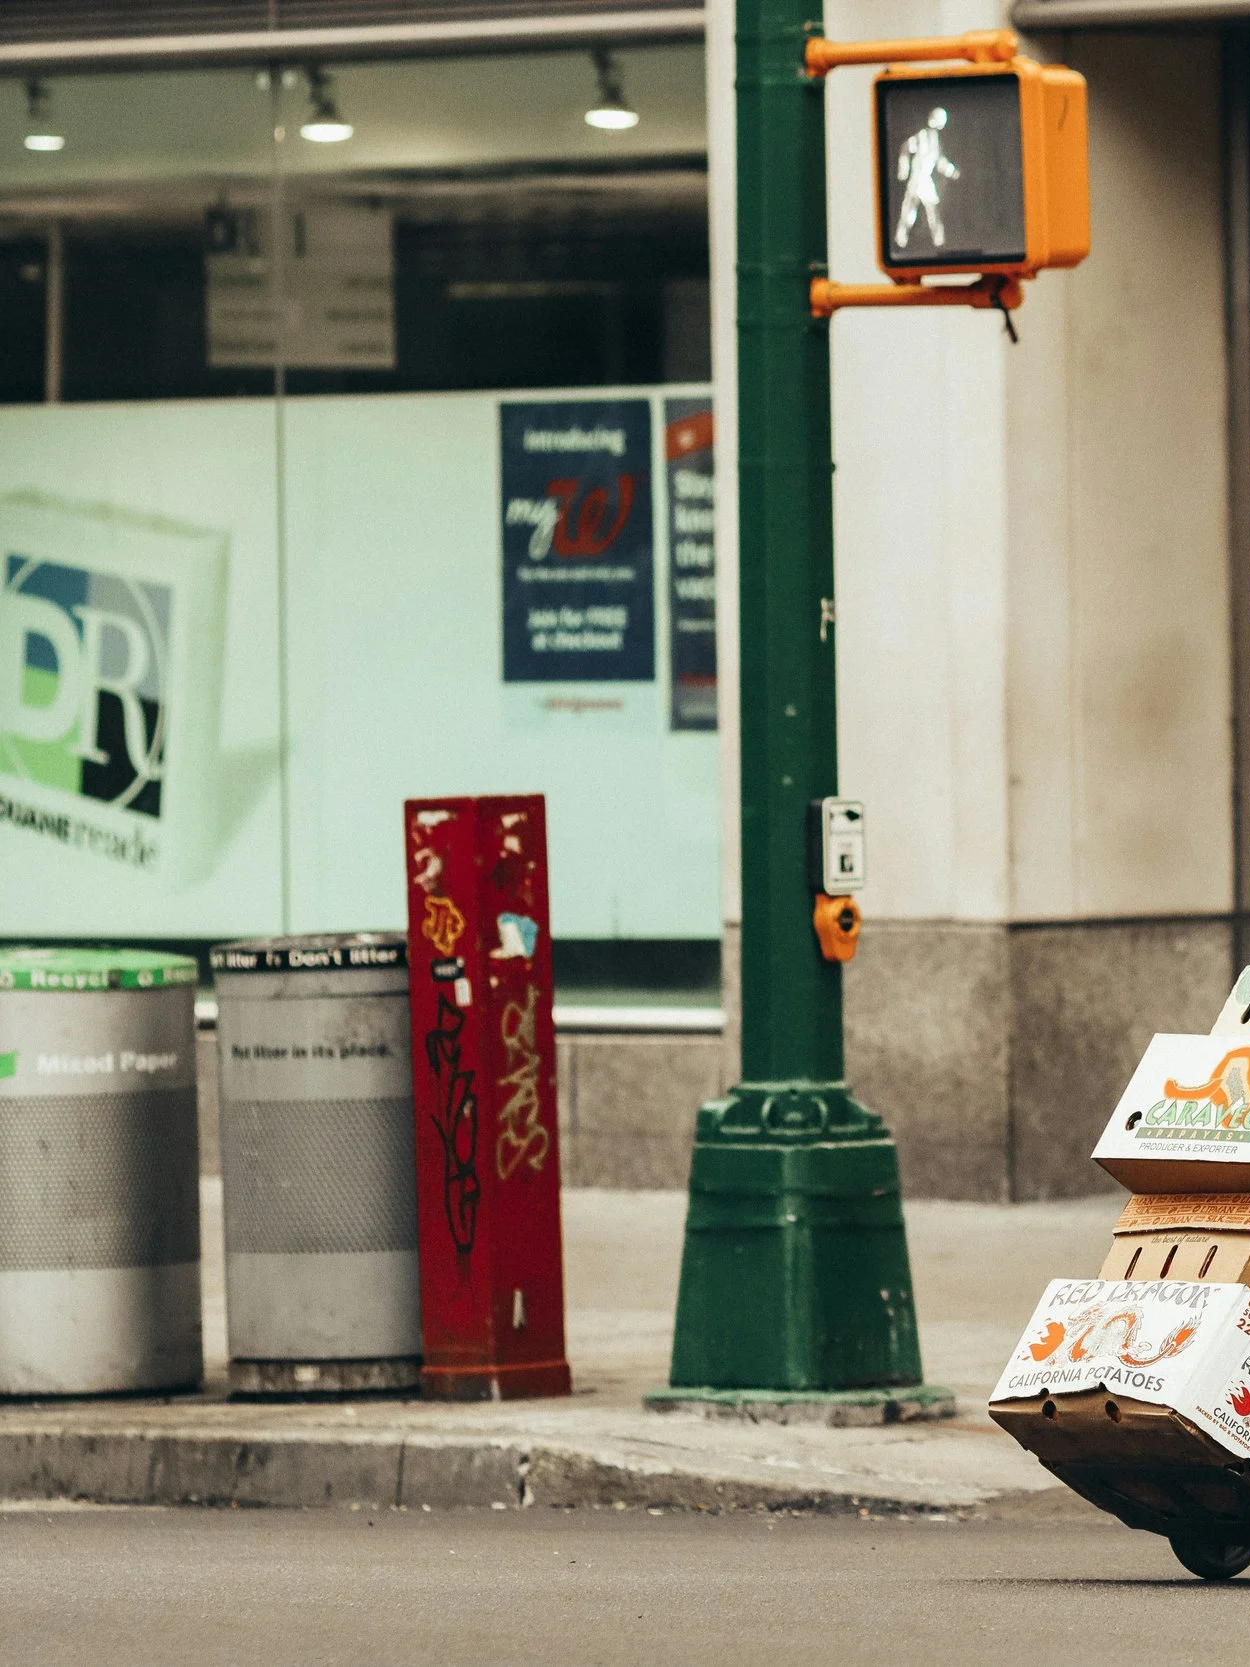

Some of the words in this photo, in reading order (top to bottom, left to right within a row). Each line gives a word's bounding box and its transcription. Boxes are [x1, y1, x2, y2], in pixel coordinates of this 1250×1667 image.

[523, 425, 627, 458] introducing
[289, 949, 342, 968] Don't
[350, 949, 398, 966] litter
[31, 969, 112, 989] Recycl
[291, 1043, 306, 1059] in
[37, 1052, 114, 1074] Mixed
[119, 1052, 177, 1073] Paper
[1155, 1130, 1234, 1141] PAPAYAS
[1139, 1142, 1184, 1152] PRODUCER
[1185, 1144, 1191, 1152] &
[1192, 1145, 1239, 1154] EXPORTER
[1160, 1216, 1192, 1224] LIPMAN
[1206, 1215, 1226, 1223] SILK
[1199, 1206, 1235, 1214] LIPMAN
[1151, 1235, 1161, 1243] the
[1163, 1235, 1177, 1243] best
[1178, 1234, 1188, 1244] of
[1049, 1282, 1104, 1307] RED
[1008, 1367, 1082, 1389] CALIFORNIA
[1195, 1406, 1212, 1420] PACKED
[1219, 1424, 1227, 1432] BIG
